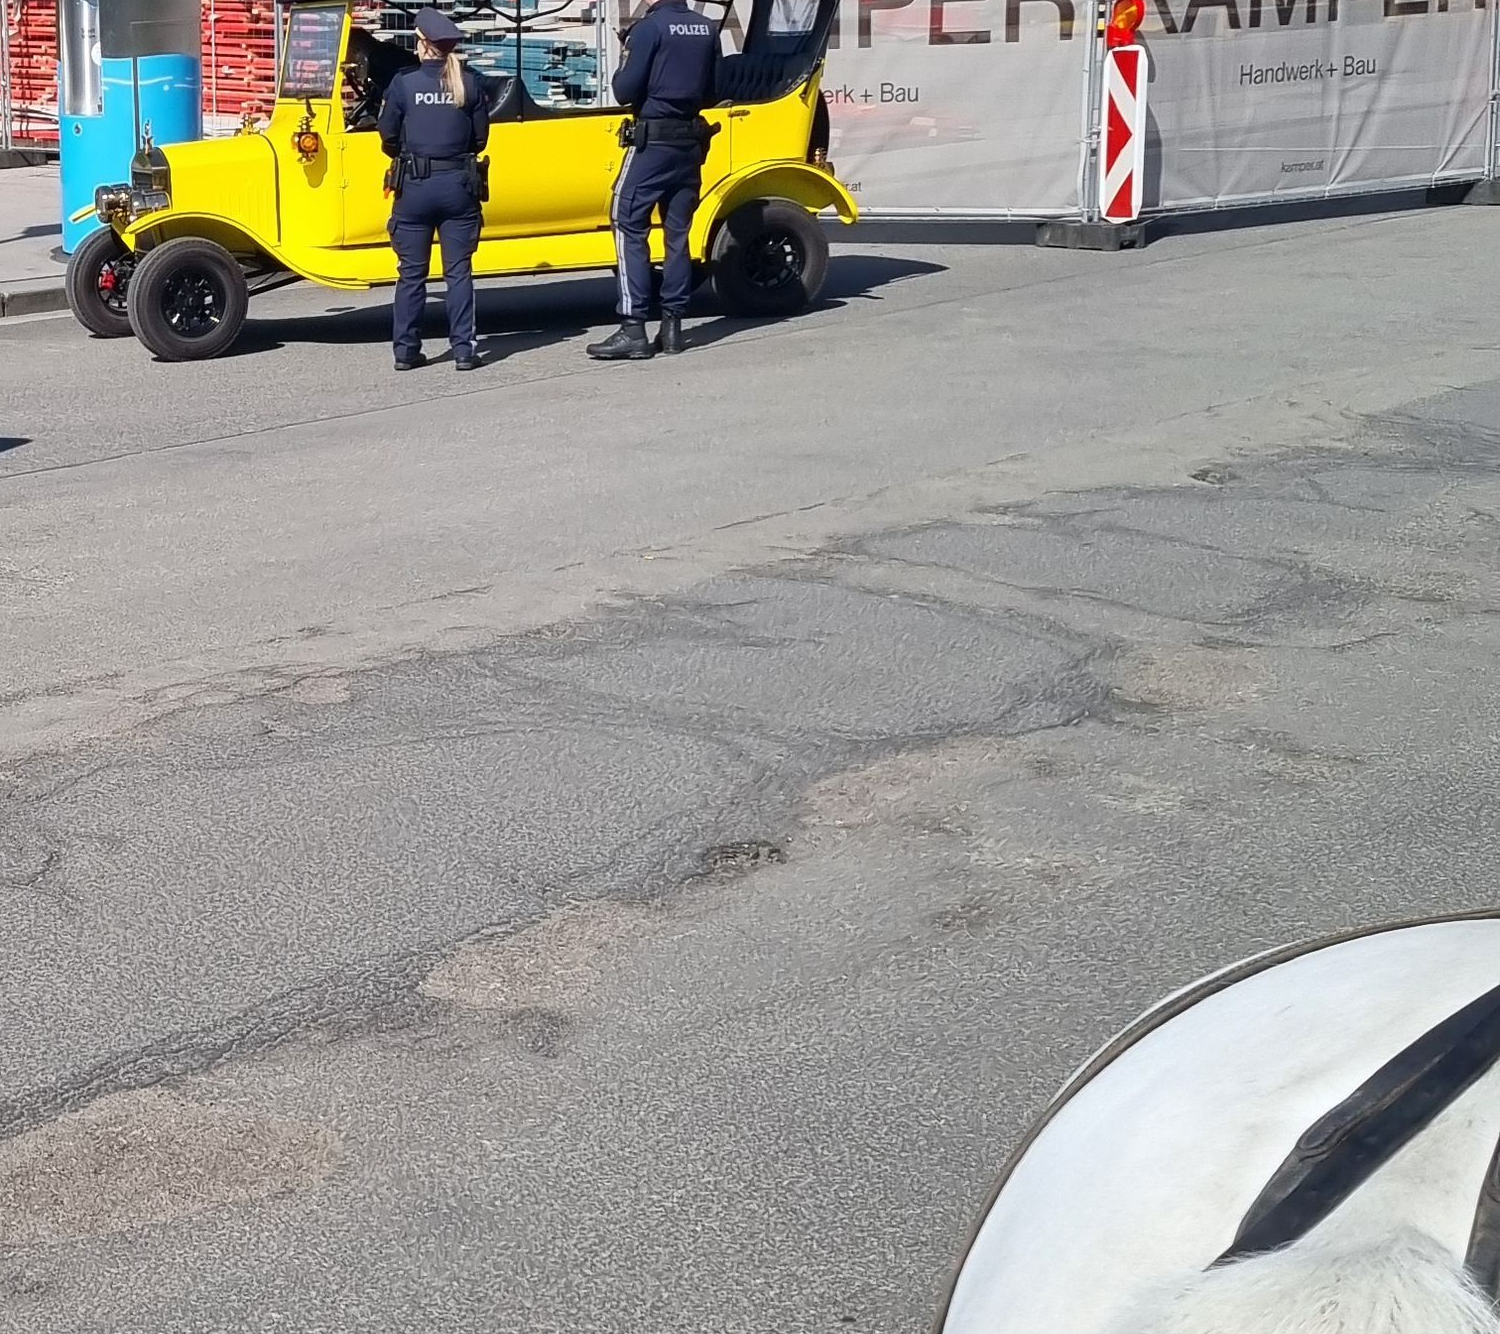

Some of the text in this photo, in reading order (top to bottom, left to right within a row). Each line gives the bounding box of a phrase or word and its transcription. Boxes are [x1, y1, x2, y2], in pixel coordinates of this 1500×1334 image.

[669, 23, 710, 36] POLIZEI
[1240, 55, 1376, 86] Handwerk + Bau
[415, 91, 456, 105] POLIZ
[859, 88, 873, 104] +
[880, 82, 919, 103] Bau
